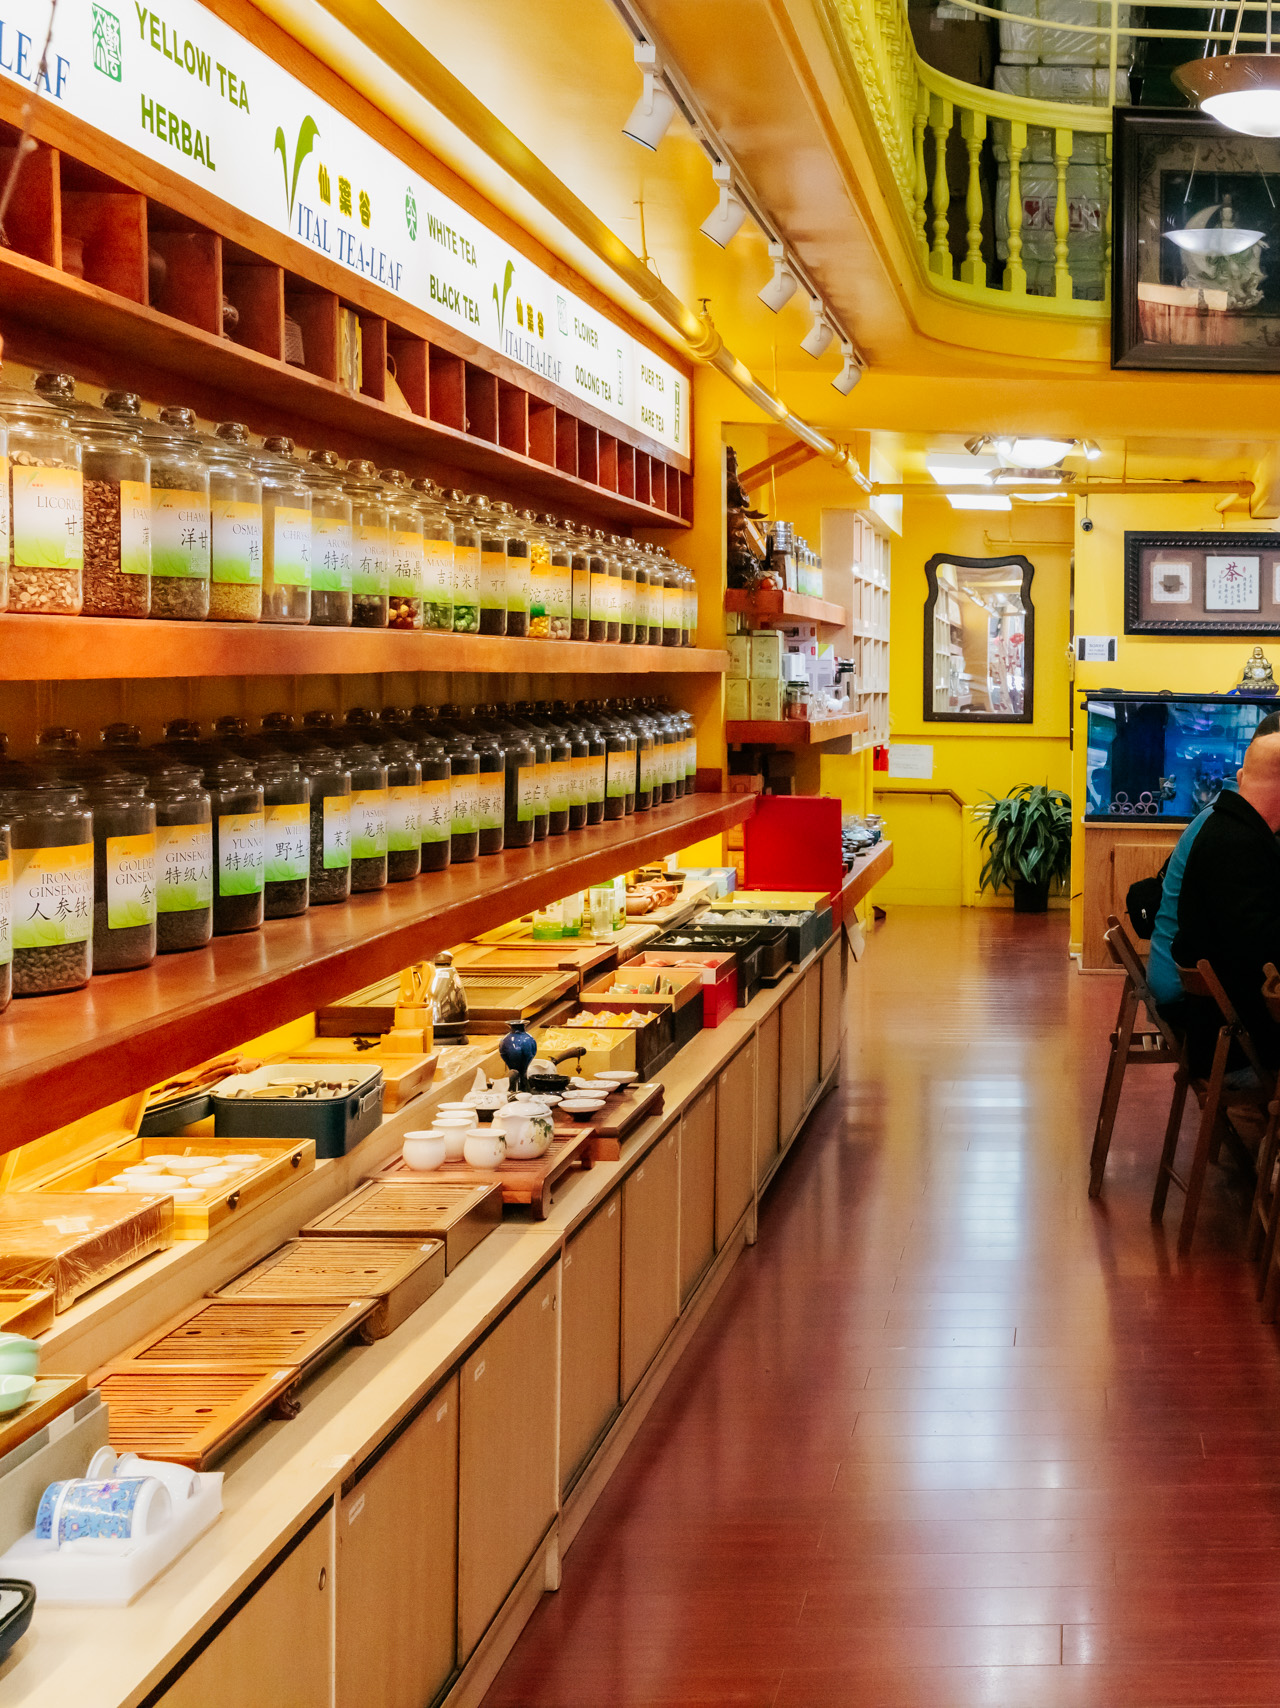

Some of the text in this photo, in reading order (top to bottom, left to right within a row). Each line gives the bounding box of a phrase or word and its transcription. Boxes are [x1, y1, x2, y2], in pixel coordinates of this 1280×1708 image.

[135, 0, 211, 87] YELLOW
[216, 62, 250, 115] TEA
[141, 93, 216, 172] HERBAL
[427, 212, 458, 256] WHITE
[460, 236, 478, 269] TEA
[337, 227, 403, 292] TEA-LEAF
[429, 273, 480, 326] BLACK TEA
[574, 317, 599, 349] FLOWER
[525, 341, 562, 383] TEA-LEAF
[575, 365, 600, 396] OOLONG
[601, 380, 612, 403] TEA
[641, 364, 654, 389] PUER
[655, 373, 665, 393] TEA
[641, 406, 665, 433] RARE TEA
[360, 556, 388, 574] 有机
[1222, 561, 1244, 582] 茶
[275, 840, 310, 862] 野生
[41, 872, 71, 885] IRON
[165, 865, 212, 885] 特级人
[29, 884, 81, 899] GINSENG
[26, 896, 91, 923] 人参铁
